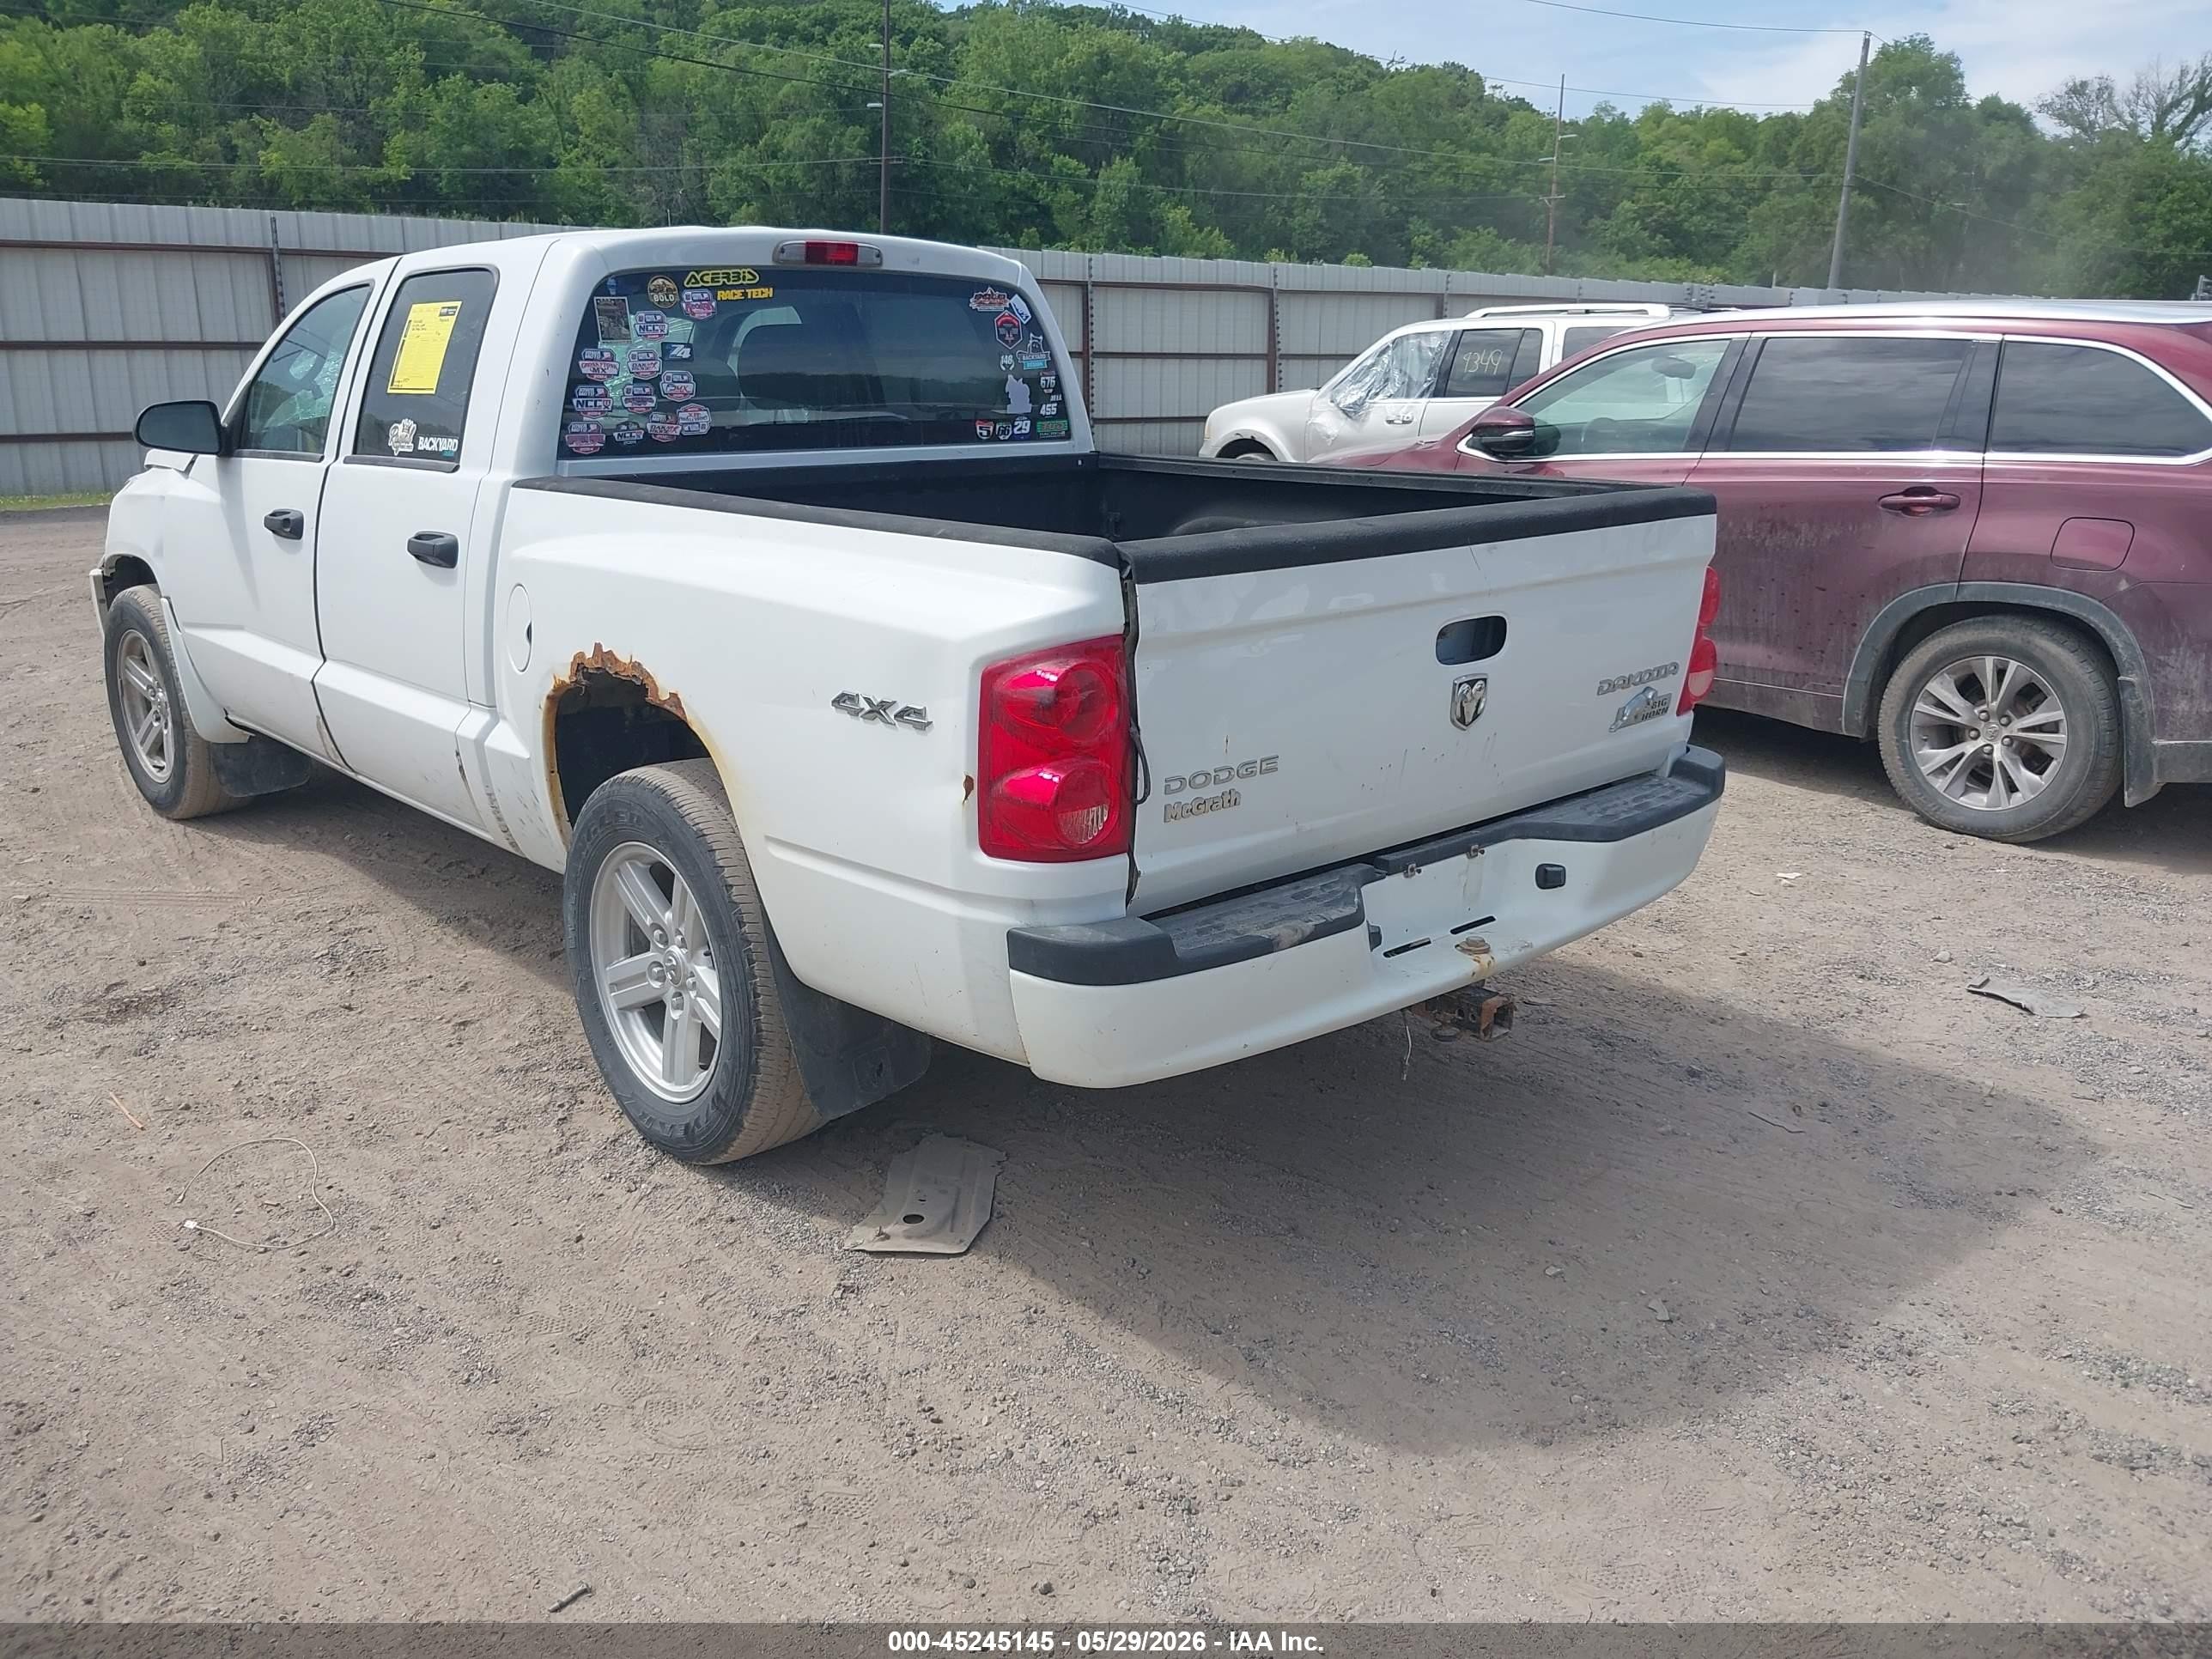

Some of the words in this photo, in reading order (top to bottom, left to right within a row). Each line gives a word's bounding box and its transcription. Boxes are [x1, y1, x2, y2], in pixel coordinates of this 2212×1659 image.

[717, 289, 744, 301] RACE
[746, 287, 773, 299] TECH
[670, 344, 691, 359] 74
[1040, 403, 1058, 416] 455
[1013, 420, 1031, 434] 29
[417, 436, 459, 452] BACKYARD
[1650, 697, 1668, 710] BIG
[1641, 706, 1669, 721] HORN
[1164, 754, 1279, 795] DODGE
[1163, 787, 1243, 823] McGrath
